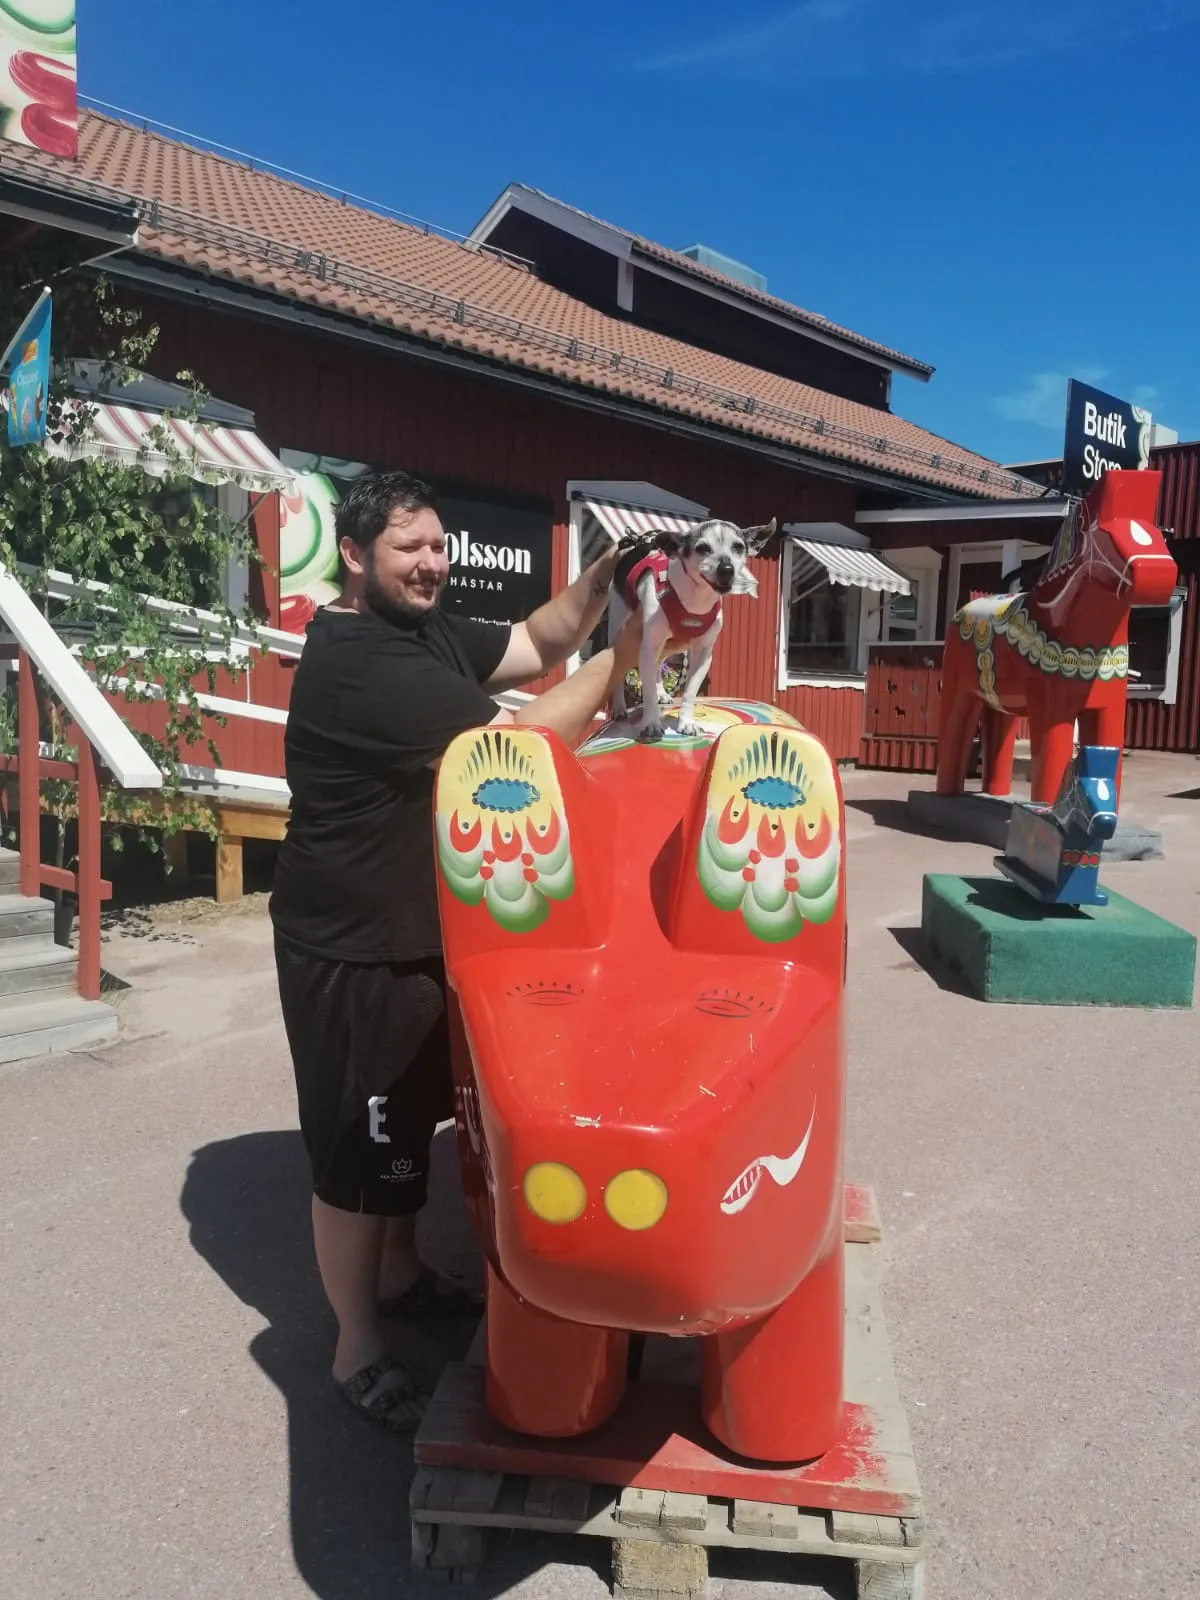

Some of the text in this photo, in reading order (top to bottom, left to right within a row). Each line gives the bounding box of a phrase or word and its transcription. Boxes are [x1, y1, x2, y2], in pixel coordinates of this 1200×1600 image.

[1084, 400, 1127, 449] Butik
[444, 530, 531, 574] Olsson
[450, 576, 503, 591] HÄSTAR
[368, 1095, 391, 1143] E
